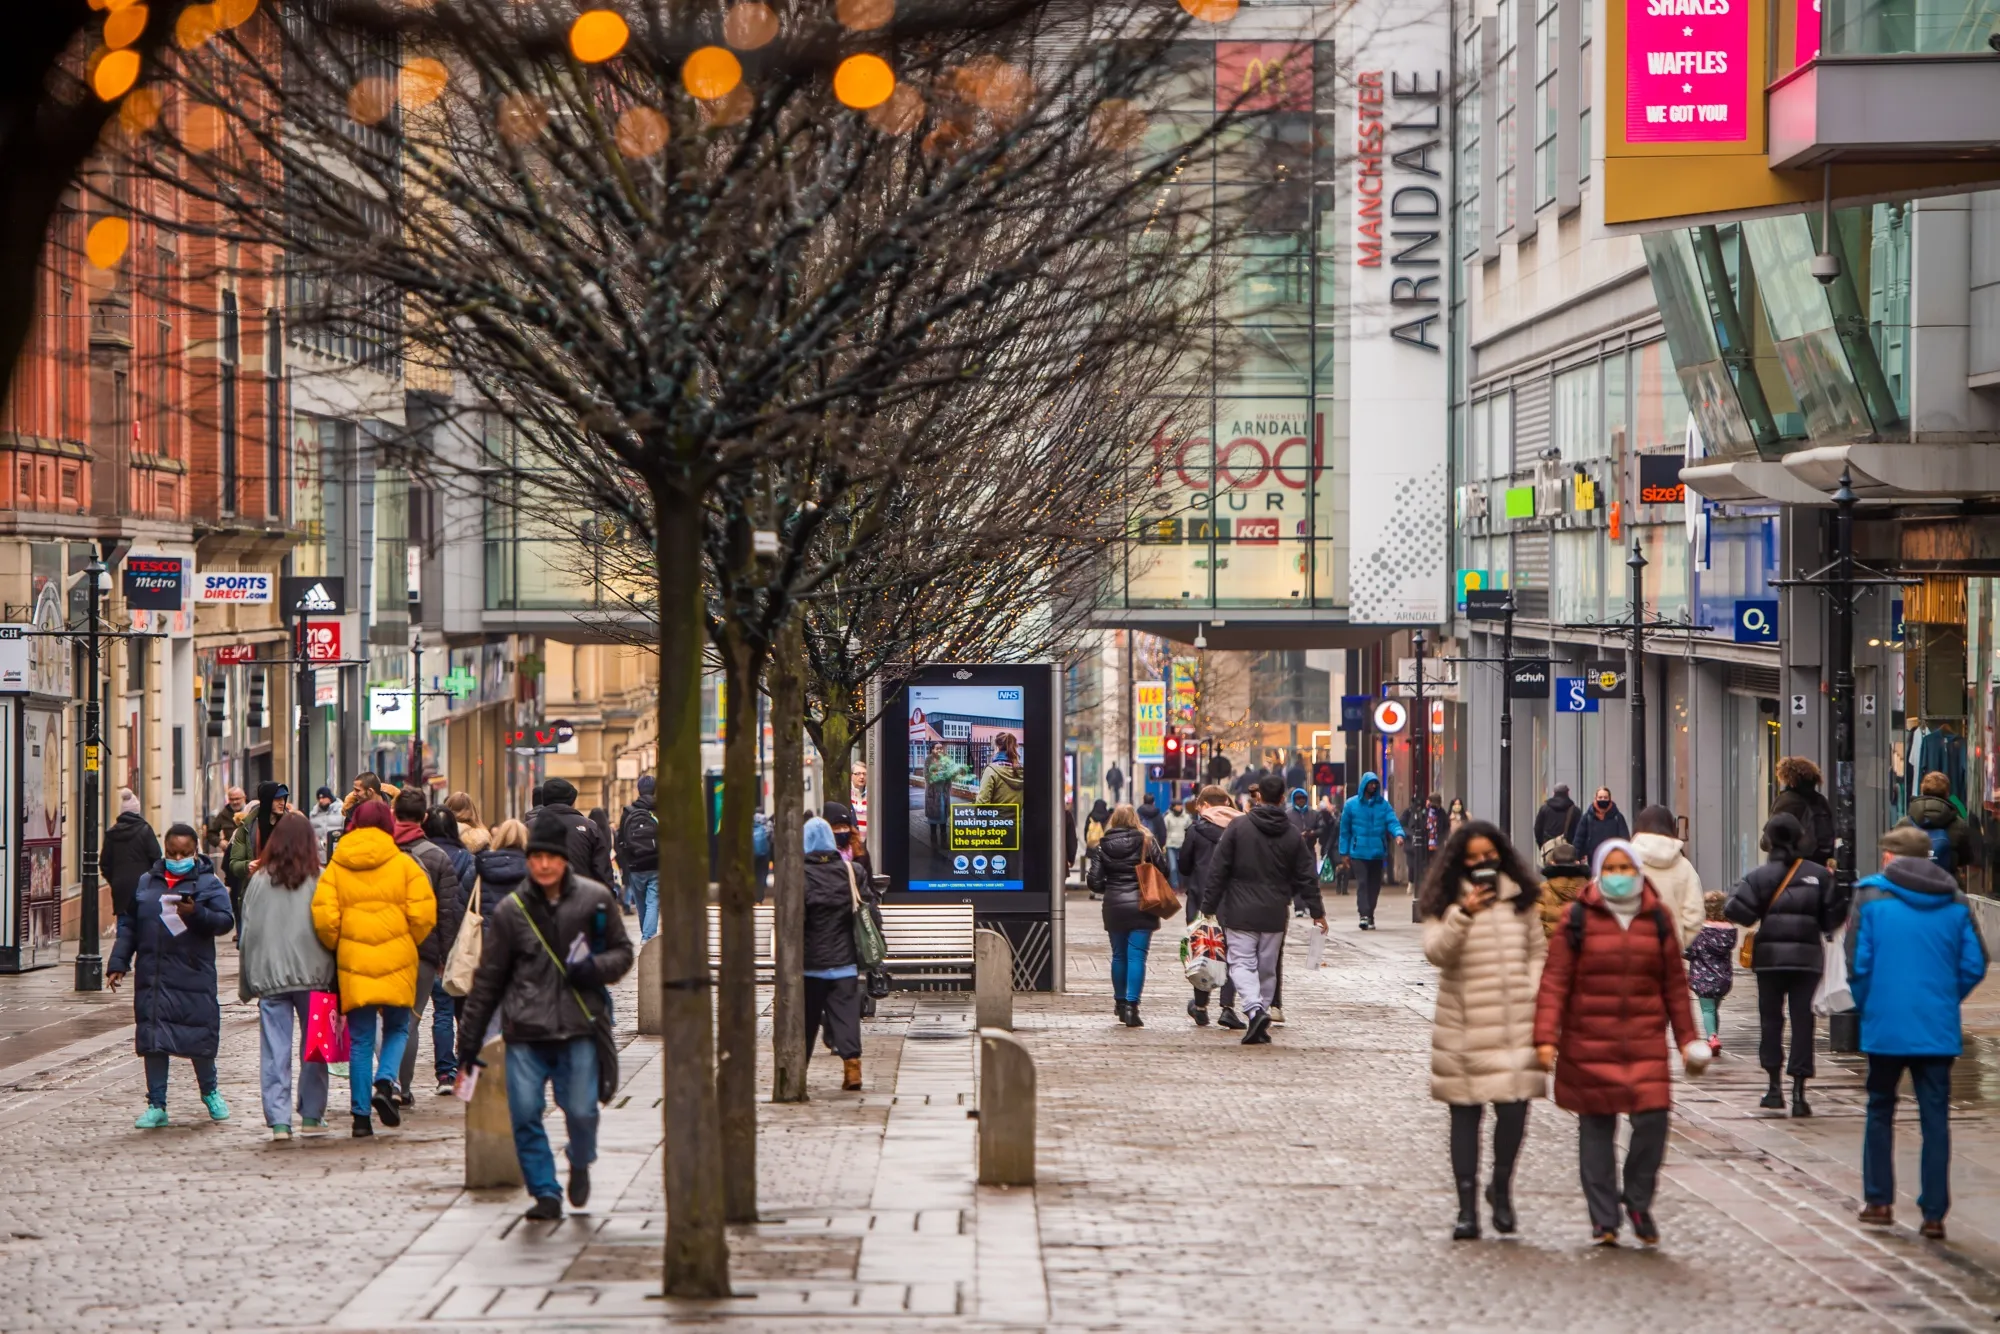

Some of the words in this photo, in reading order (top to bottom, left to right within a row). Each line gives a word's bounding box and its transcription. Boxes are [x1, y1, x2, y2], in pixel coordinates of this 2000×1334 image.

[1647, 0, 1730, 16] SHAKES
[1647, 51, 1727, 75] WAFFLES
[1646, 105, 1667, 124] WE
[1669, 104, 1695, 122] GOT
[1697, 104, 1728, 122] YOU!
[1357, 71, 1383, 267] MANCHESTER
[1391, 69, 1441, 351] ARNDALE
[1642, 484, 1685, 502] size?
[1239, 525, 1276, 538] KFC
[129, 561, 181, 572] TESCO
[135, 577, 176, 588] Metro
[205, 576, 267, 589] SPORTS
[1395, 611, 1437, 621] ARNDALE
[1515, 672, 1545, 682] schuh
[1570, 680, 1585, 688] WH
[998, 691, 1018, 700] NHS
[1570, 686, 1586, 711] S
[1140, 705, 1163, 719] YES
[1140, 721, 1163, 736] YES
[954, 808, 975, 816] Let's
[977, 808, 998, 817] keep
[954, 818, 988, 828] making
[989, 819, 1014, 827] space
[966, 828, 986, 837] help
[986, 829, 1007, 837] stop
[971, 838, 1003, 847] spread.
